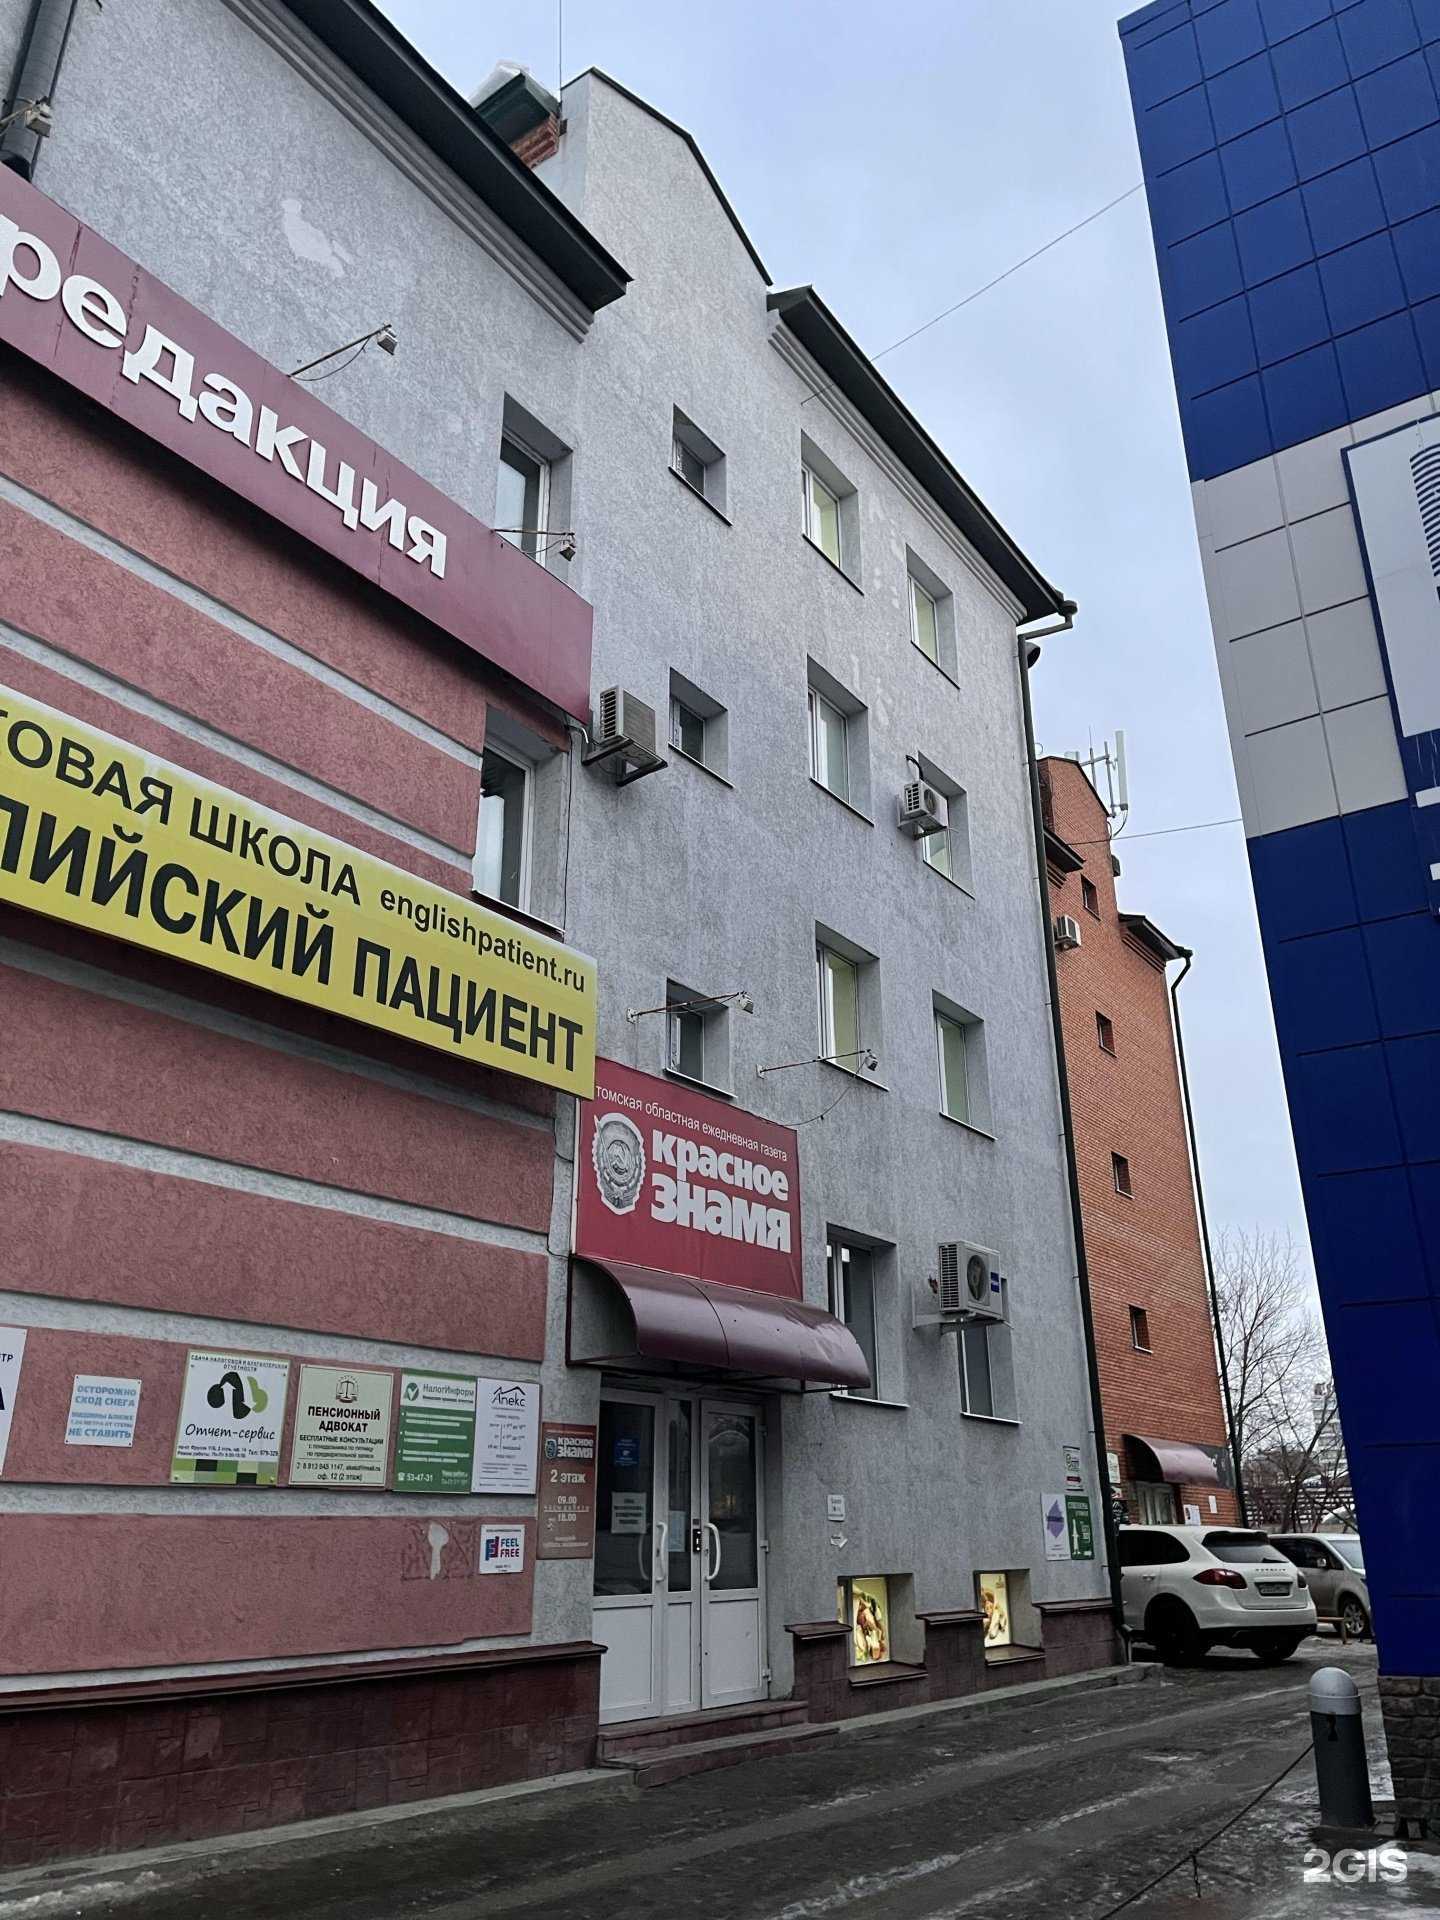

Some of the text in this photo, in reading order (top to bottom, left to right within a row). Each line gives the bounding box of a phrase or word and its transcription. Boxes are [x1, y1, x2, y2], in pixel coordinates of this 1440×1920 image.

[0, 709, 585, 994] ОВАЯ ШКОЛА englishpatient.ru
[353, 937, 583, 1072] ПАЦИЕНТ
[596, 1085, 787, 1162] томская областная ежедневная газета
[0, 1353, 14, 1363] ТР
[77, 1385, 136, 1396] ОСТОРОЖНО
[308, 1406, 381, 1421] ПЕНСИОННЫЙ
[185, 1424, 276, 1442] Отчет-сервис
[319, 1421, 368, 1433] АДВОКАТ
[299, 1434, 338, 1443] БЕСПЛАТНЫЕ
[550, 1469, 585, 1484] 2 этаж
[500, 1538, 519, 1547] FEEL
[500, 1548, 520, 1558] FREE
